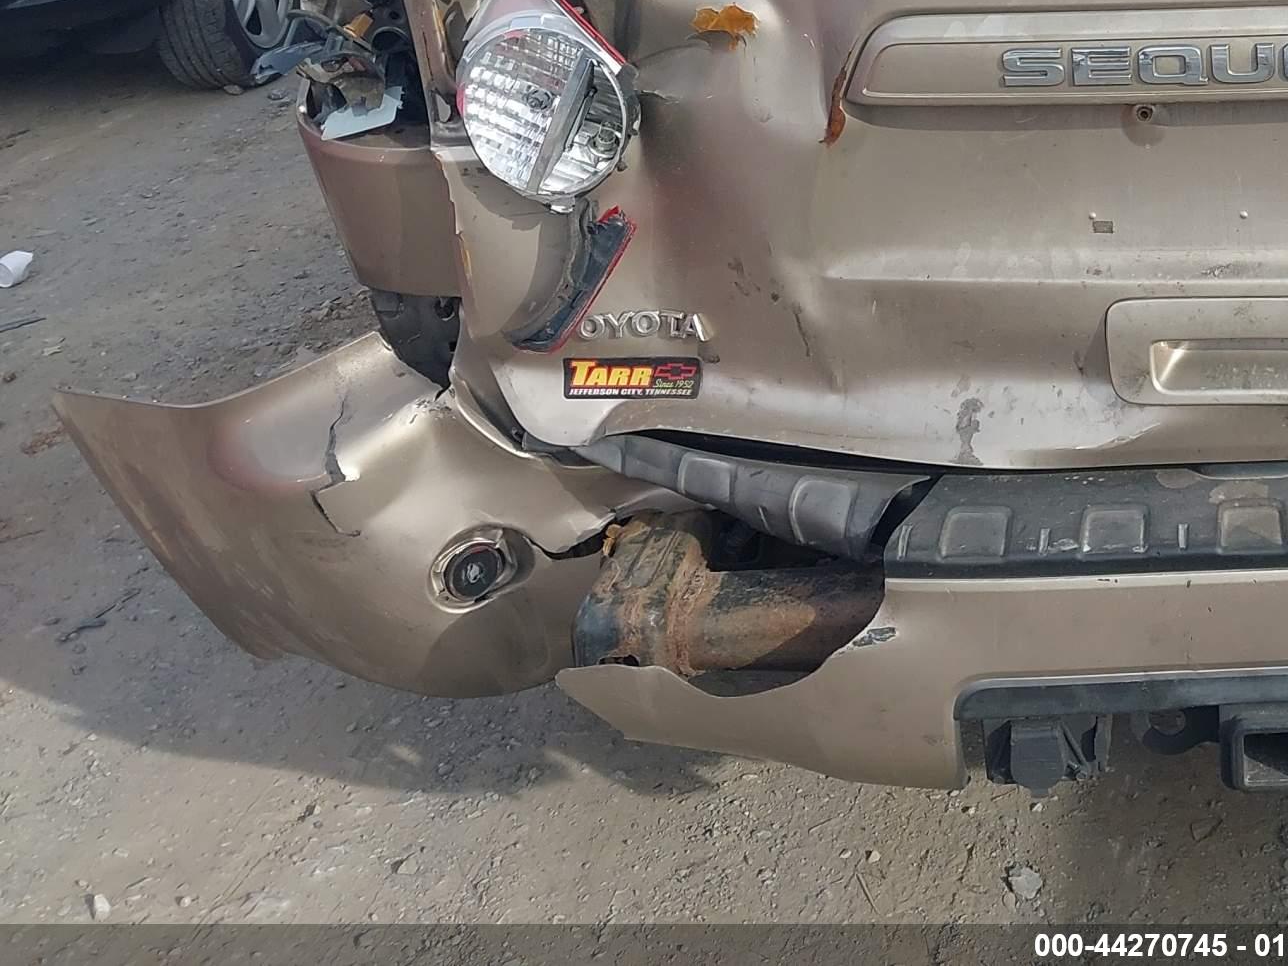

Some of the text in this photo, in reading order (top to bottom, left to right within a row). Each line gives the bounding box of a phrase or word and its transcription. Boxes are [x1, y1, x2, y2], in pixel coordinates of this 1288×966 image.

[579, 310, 709, 342] OYOTA
[568, 388, 619, 396] JEFFERSON
[644, 388, 693, 396] TENNESSEE
